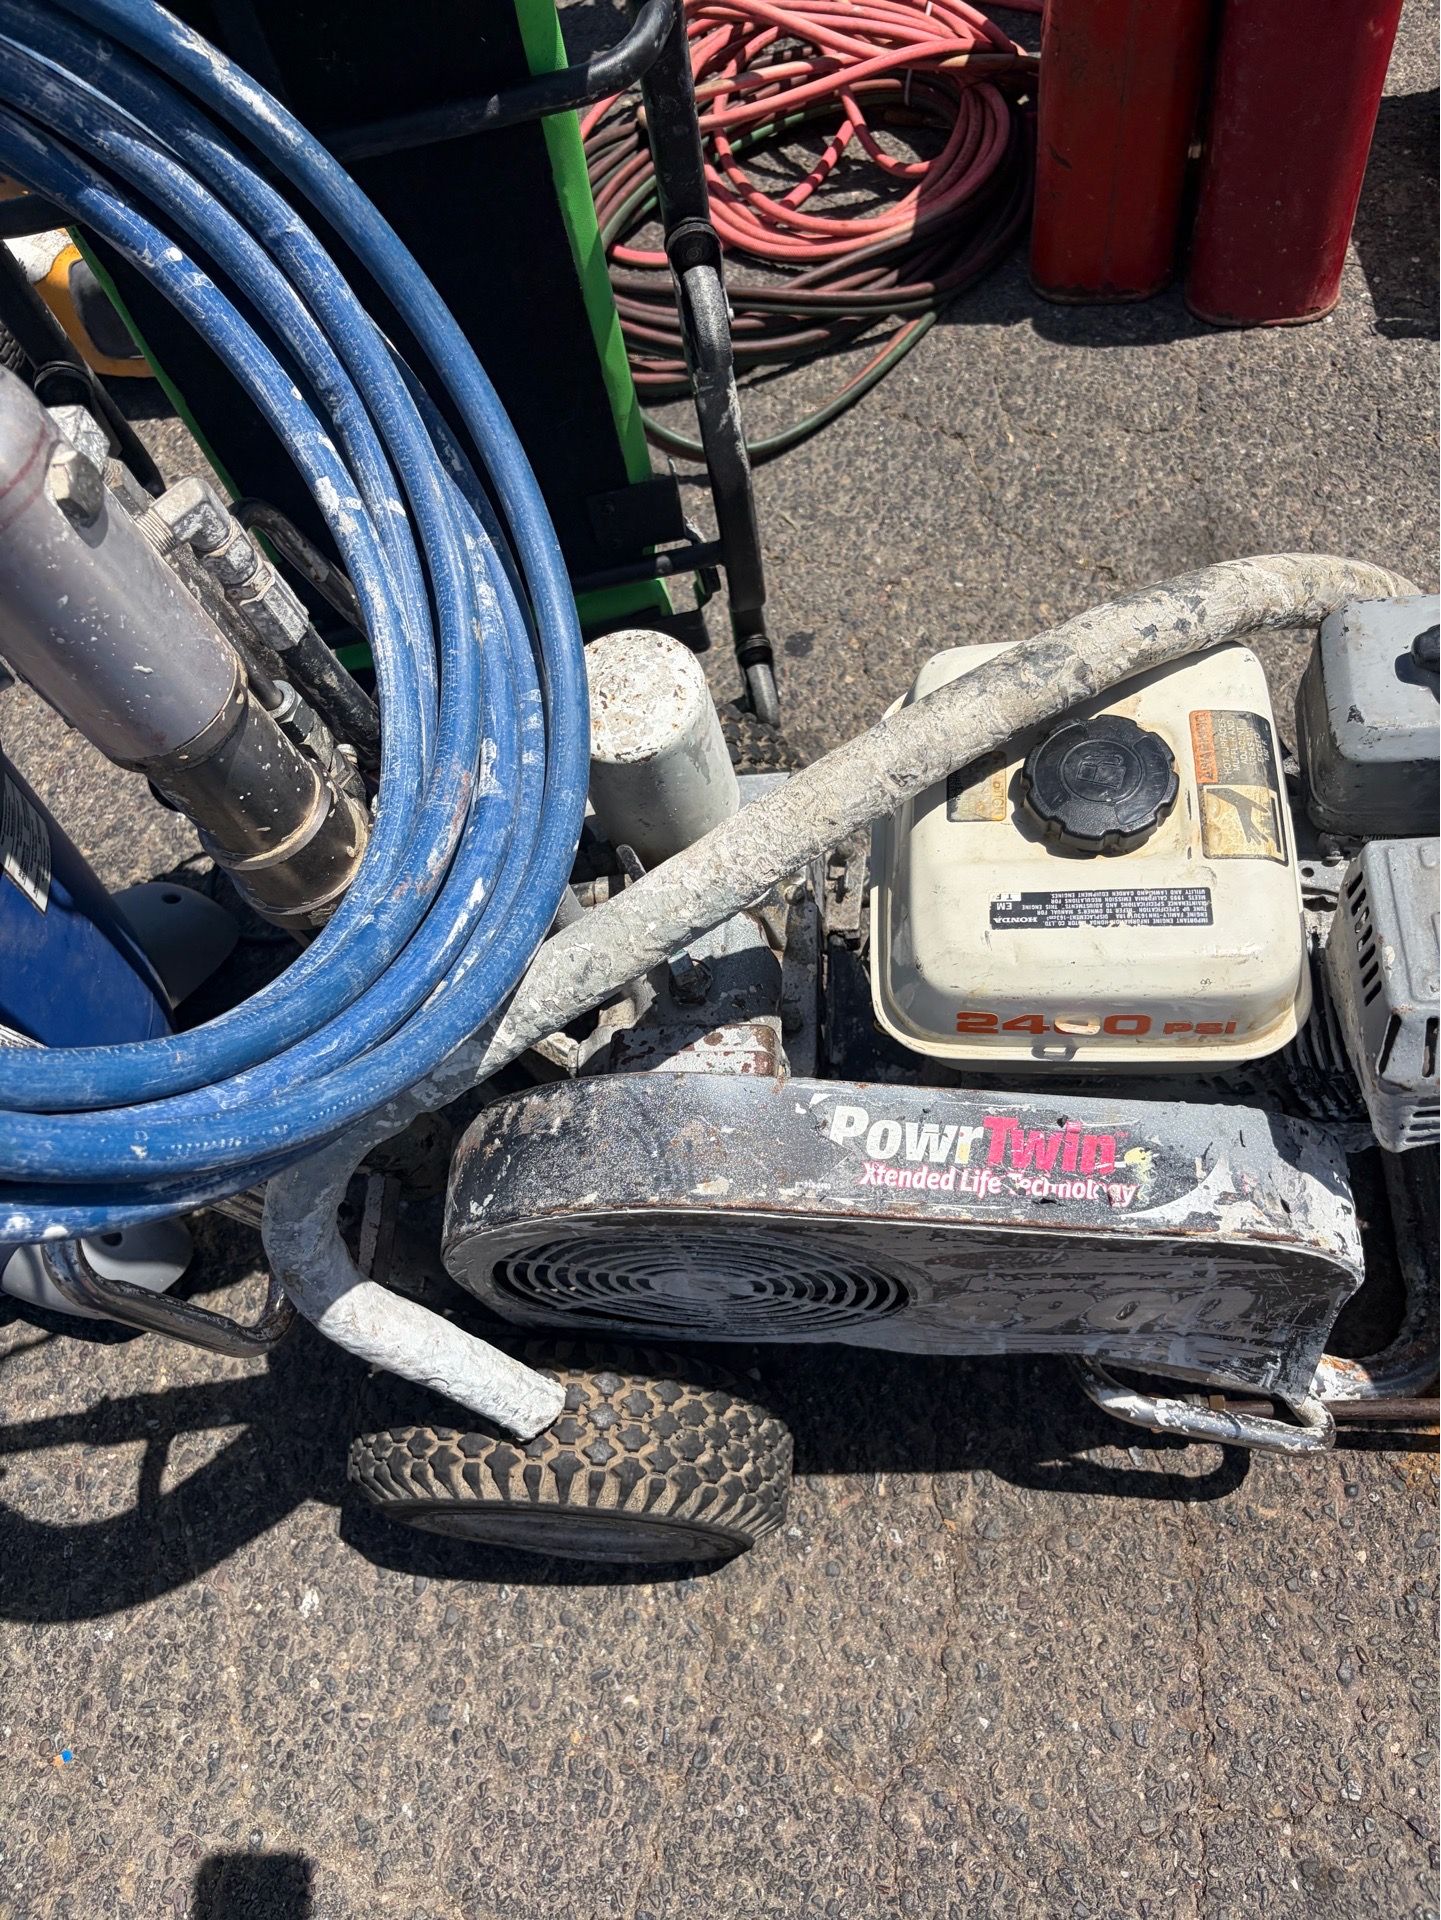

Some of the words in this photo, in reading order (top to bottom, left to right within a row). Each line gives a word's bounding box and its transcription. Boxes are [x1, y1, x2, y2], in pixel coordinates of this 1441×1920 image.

[1227, 719, 1236, 735] AND
[1222, 759, 1232, 774] HOT
[996, 902, 1013, 910] EM
[1163, 1020, 1237, 1034] PSI
[830, 1105, 1116, 1177] PowrTwin
[859, 1161, 956, 1191] Xtended
[960, 1167, 1002, 1200] Life
